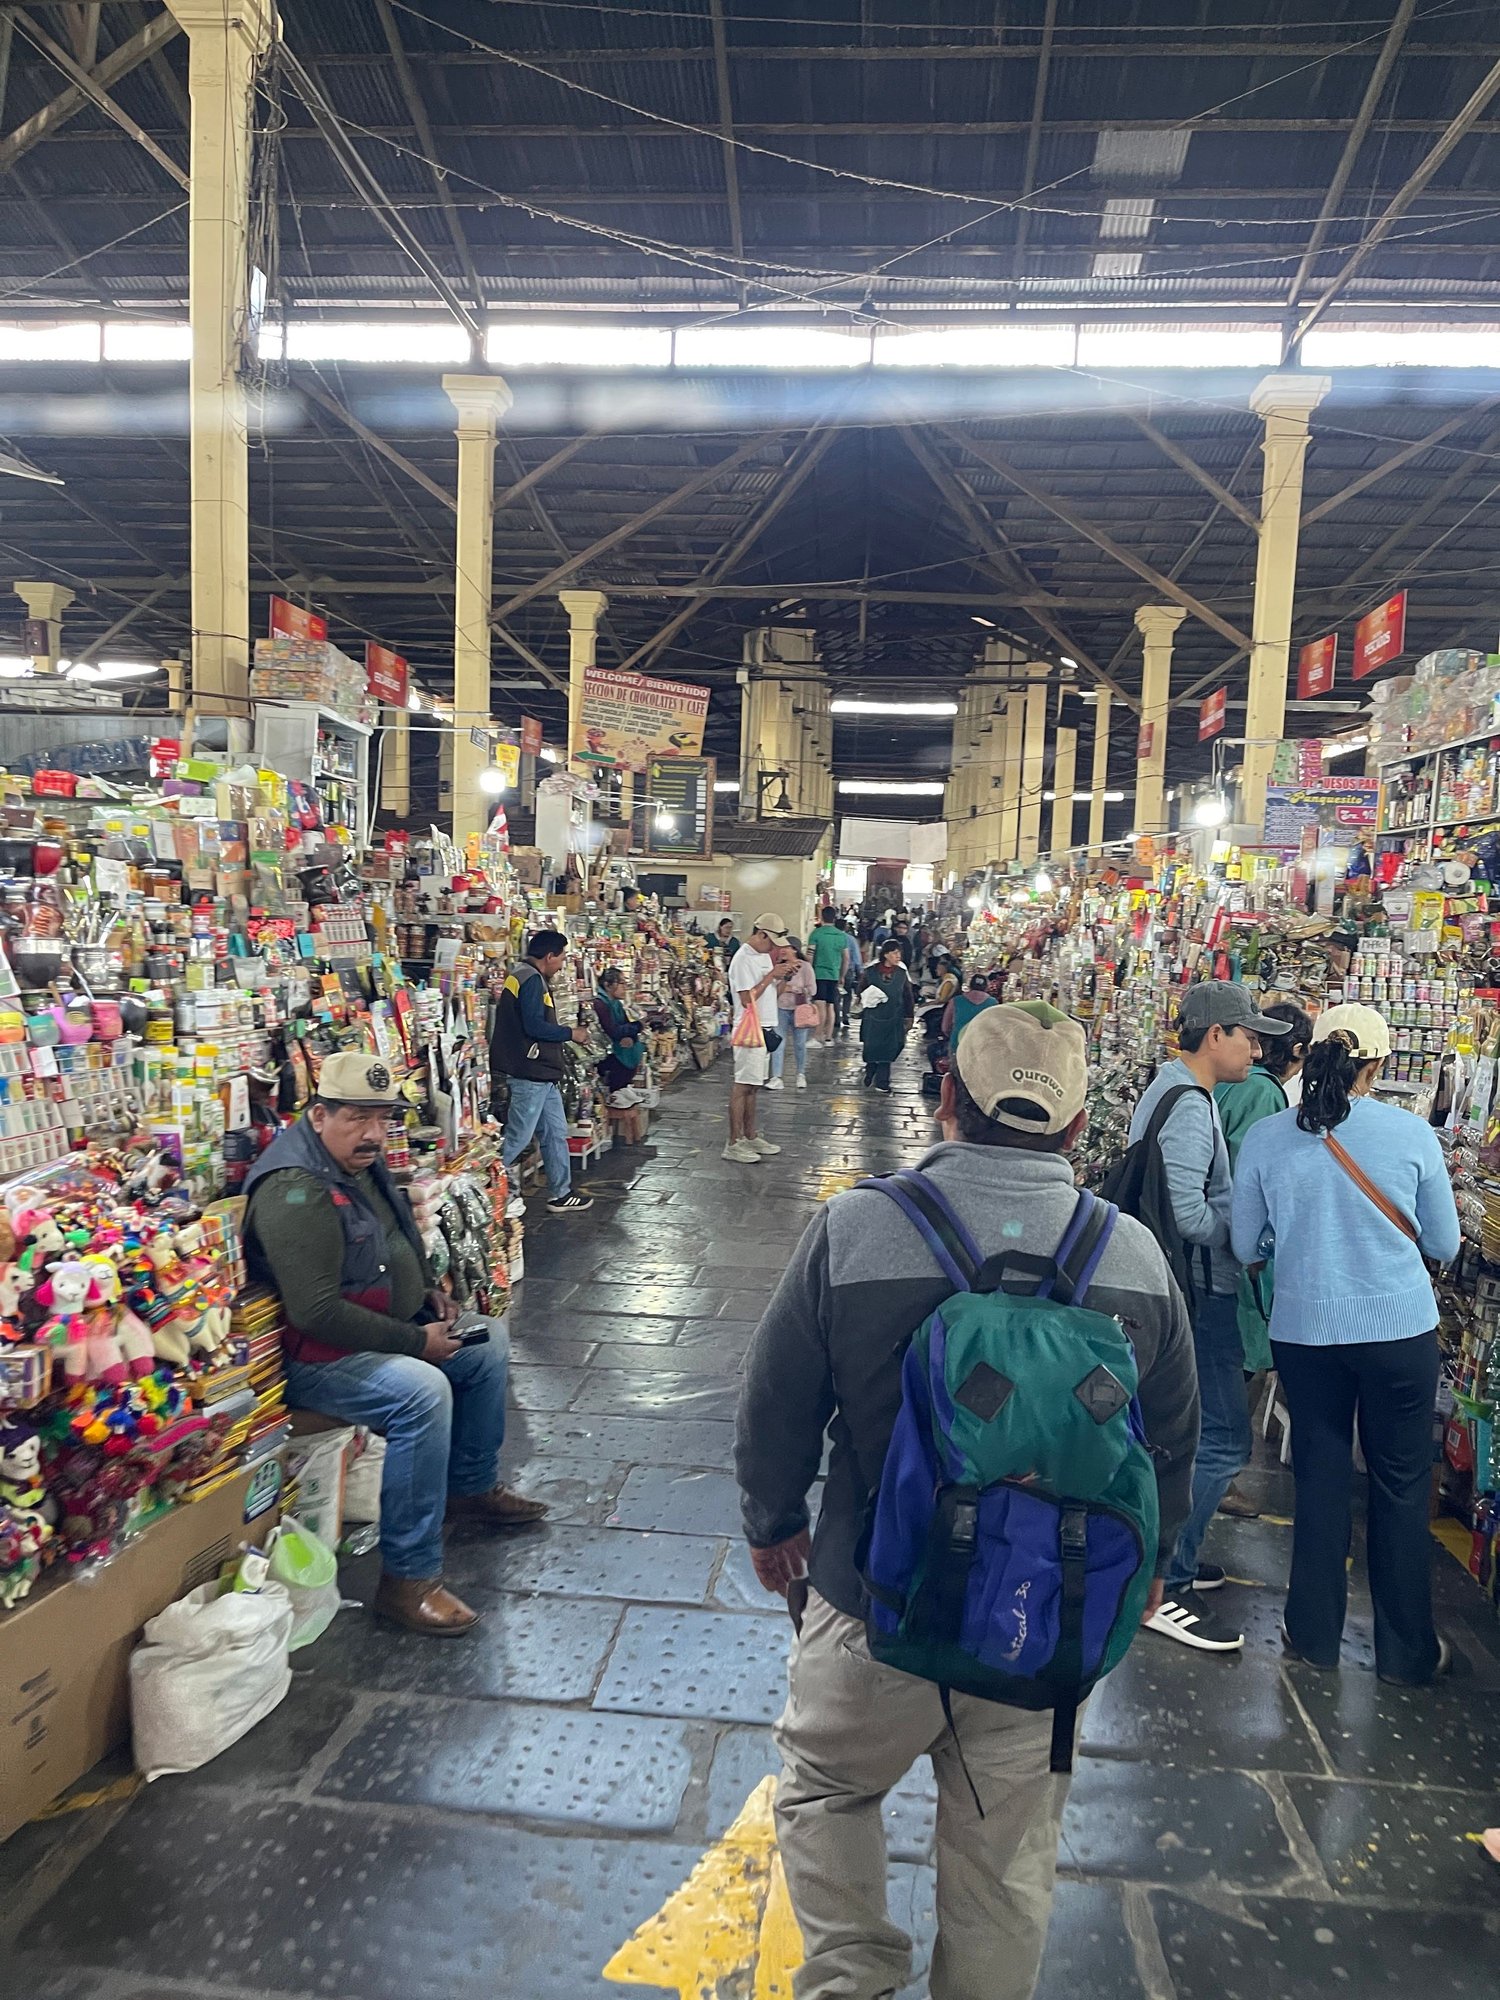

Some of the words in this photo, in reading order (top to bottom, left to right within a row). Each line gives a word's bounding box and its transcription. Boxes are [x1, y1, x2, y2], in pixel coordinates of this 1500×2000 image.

[583, 681, 615, 698] SECCION
[616, 687, 627, 700] DE
[629, 688, 677, 710] CHOCOLATES
[679, 701, 684, 712] Y
[586, 669, 644, 686] WELCOME/
[646, 679, 708, 697] BIENVENIDO
[1012, 1069, 1065, 1099] Qurawa
